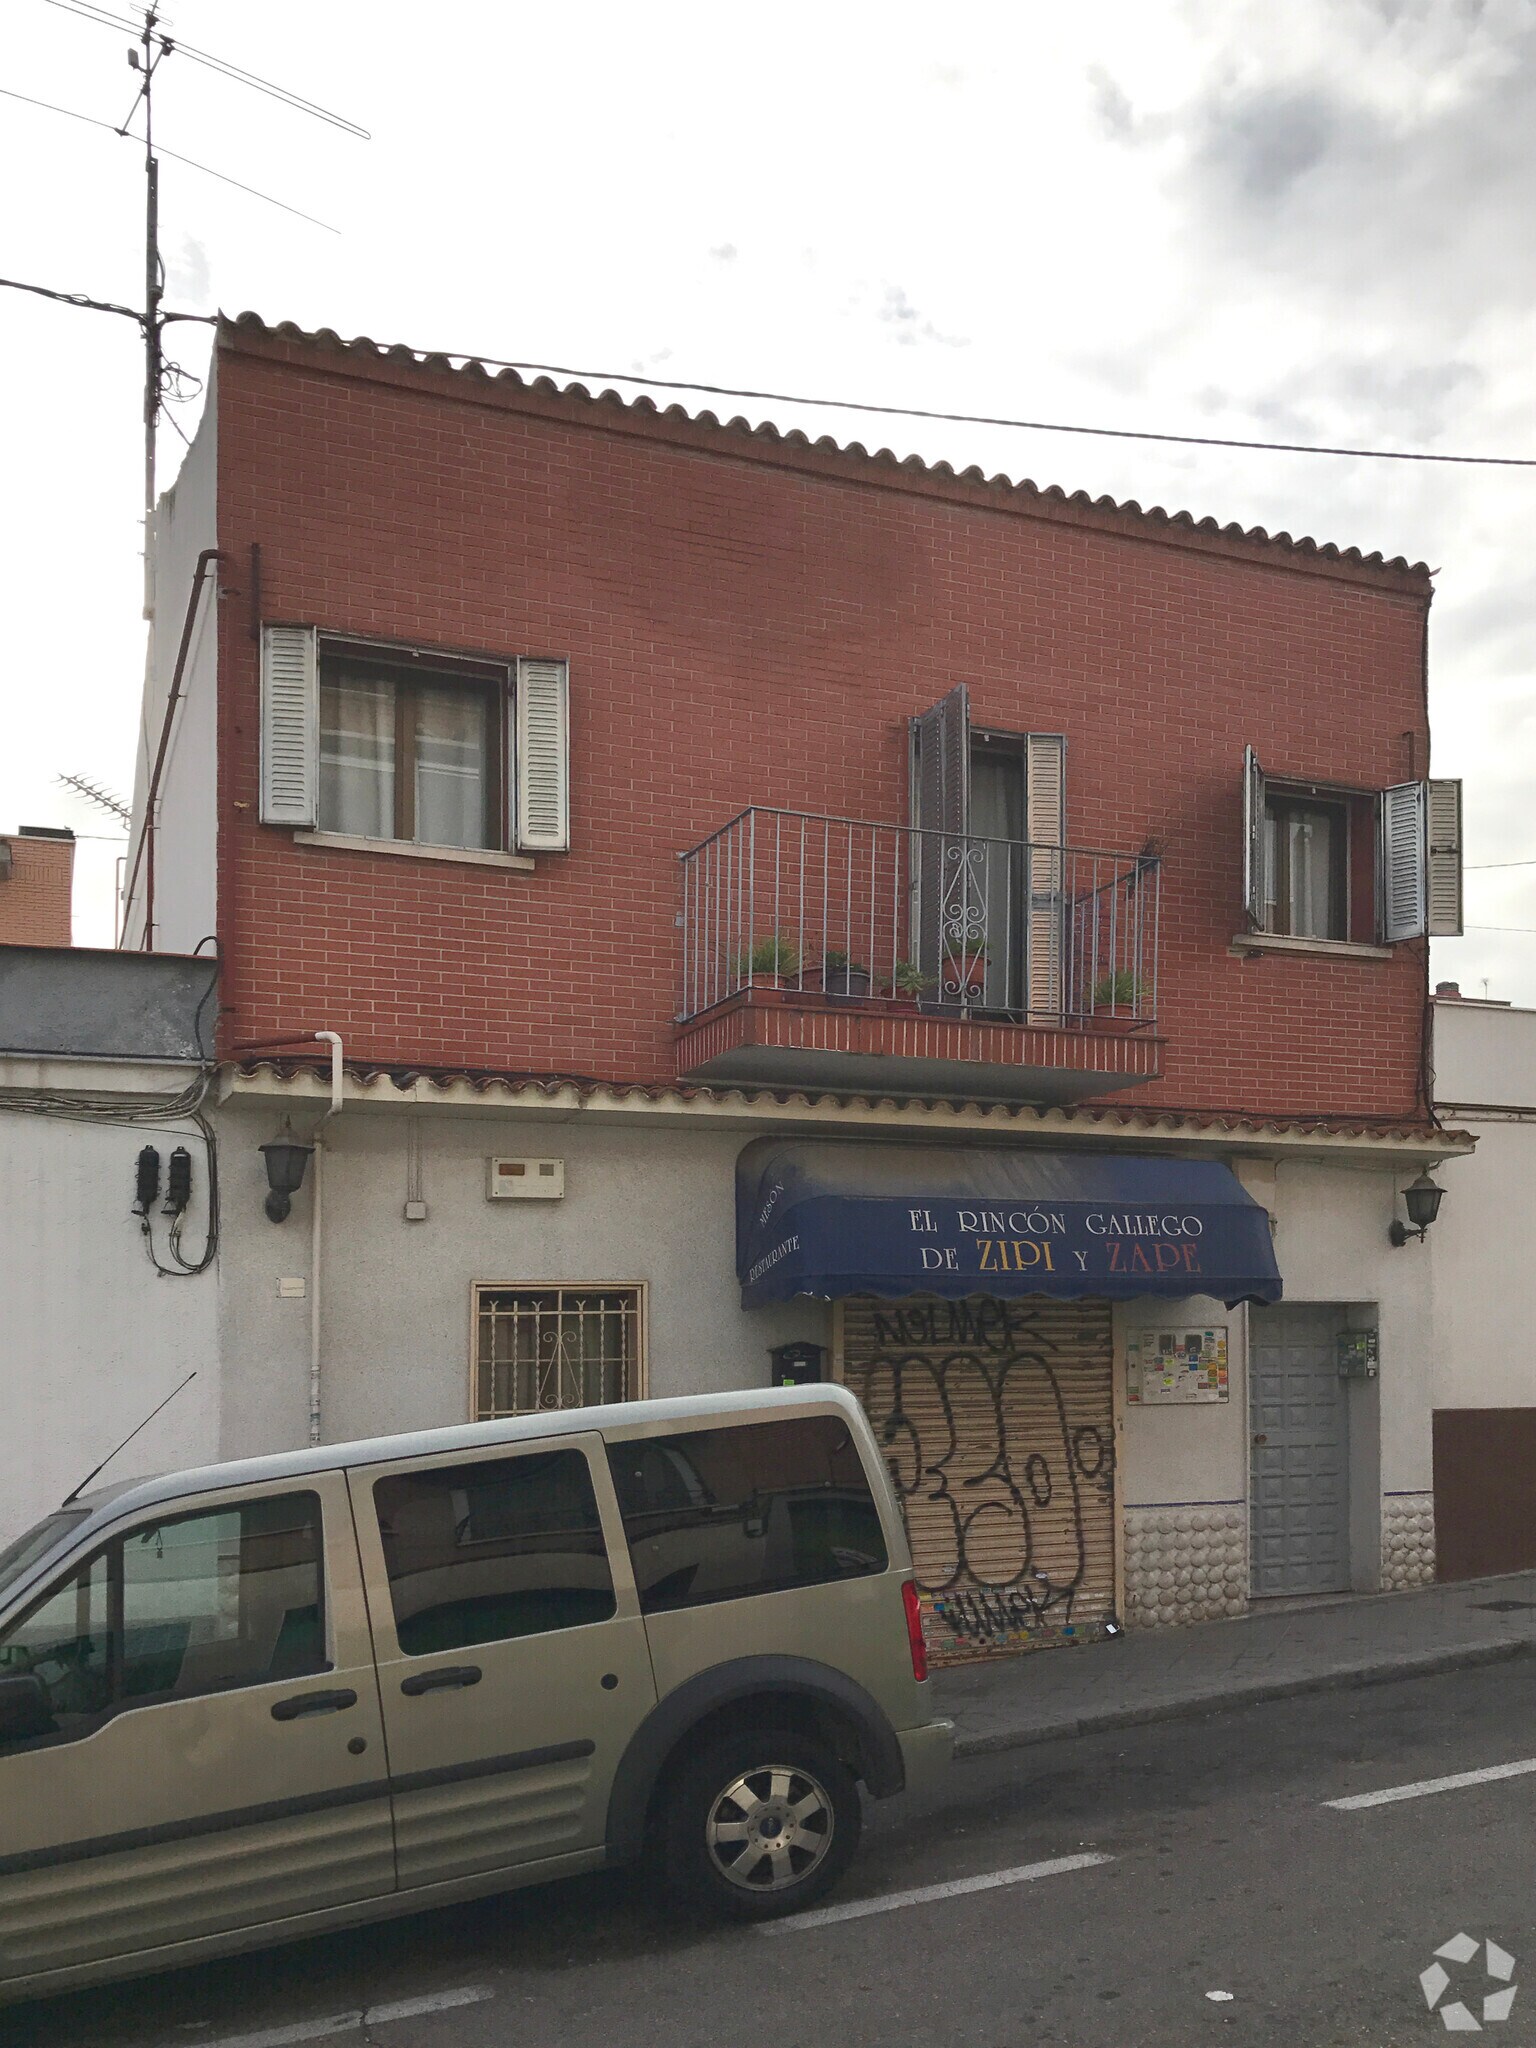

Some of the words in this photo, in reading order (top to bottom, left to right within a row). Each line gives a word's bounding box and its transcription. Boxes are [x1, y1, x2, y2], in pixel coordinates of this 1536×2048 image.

[908, 1209, 938, 1233] EL
[956, 1205, 1066, 1234] RINCÓN
[1085, 1213, 1203, 1237] GALLEGO
[748, 1234, 800, 1282] RESTAURANTE
[920, 1247, 959, 1271] DE
[976, 1238, 1056, 1272] ZIPI
[1072, 1250, 1089, 1272] Y
[1105, 1241, 1200, 1273] ZAPE
